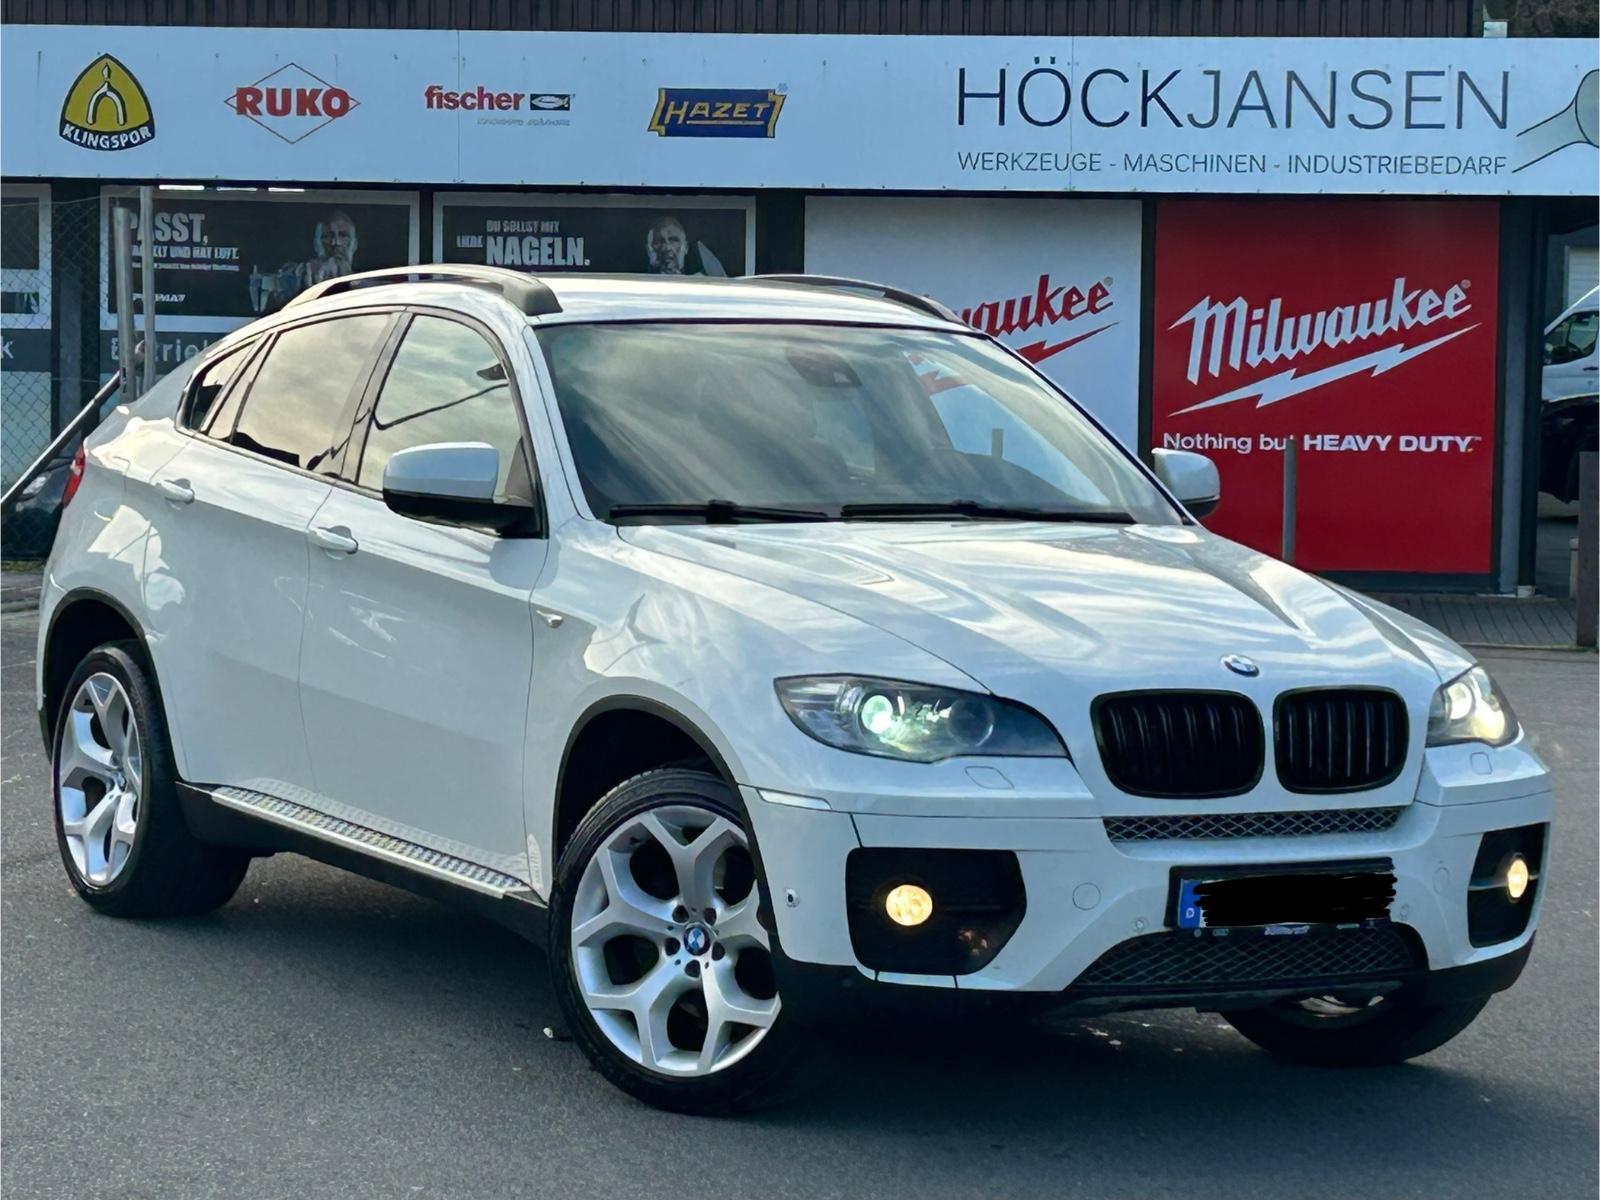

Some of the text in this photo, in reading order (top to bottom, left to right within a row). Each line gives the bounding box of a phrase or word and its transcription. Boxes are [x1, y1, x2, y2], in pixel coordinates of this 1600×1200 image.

[235, 86, 351, 118] RUKO
[424, 84, 525, 111] fischer
[958, 56, 1509, 130] HÖCKJANSEN
[664, 101, 771, 124] HAZET
[62, 123, 152, 149] KLINGSPOR
[958, 151, 1102, 172] WERKZEUGE
[1123, 153, 1267, 173] MASCHINEN
[1288, 154, 1508, 175] INDUSTRIEBEDARF
[129, 211, 209, 245] SST,
[486, 235, 591, 267] NAGELN.
[1167, 277, 1473, 386] Milwaukee
[1163, 433, 1252, 454] Nothing
[1303, 434, 1393, 452] HEAVY
